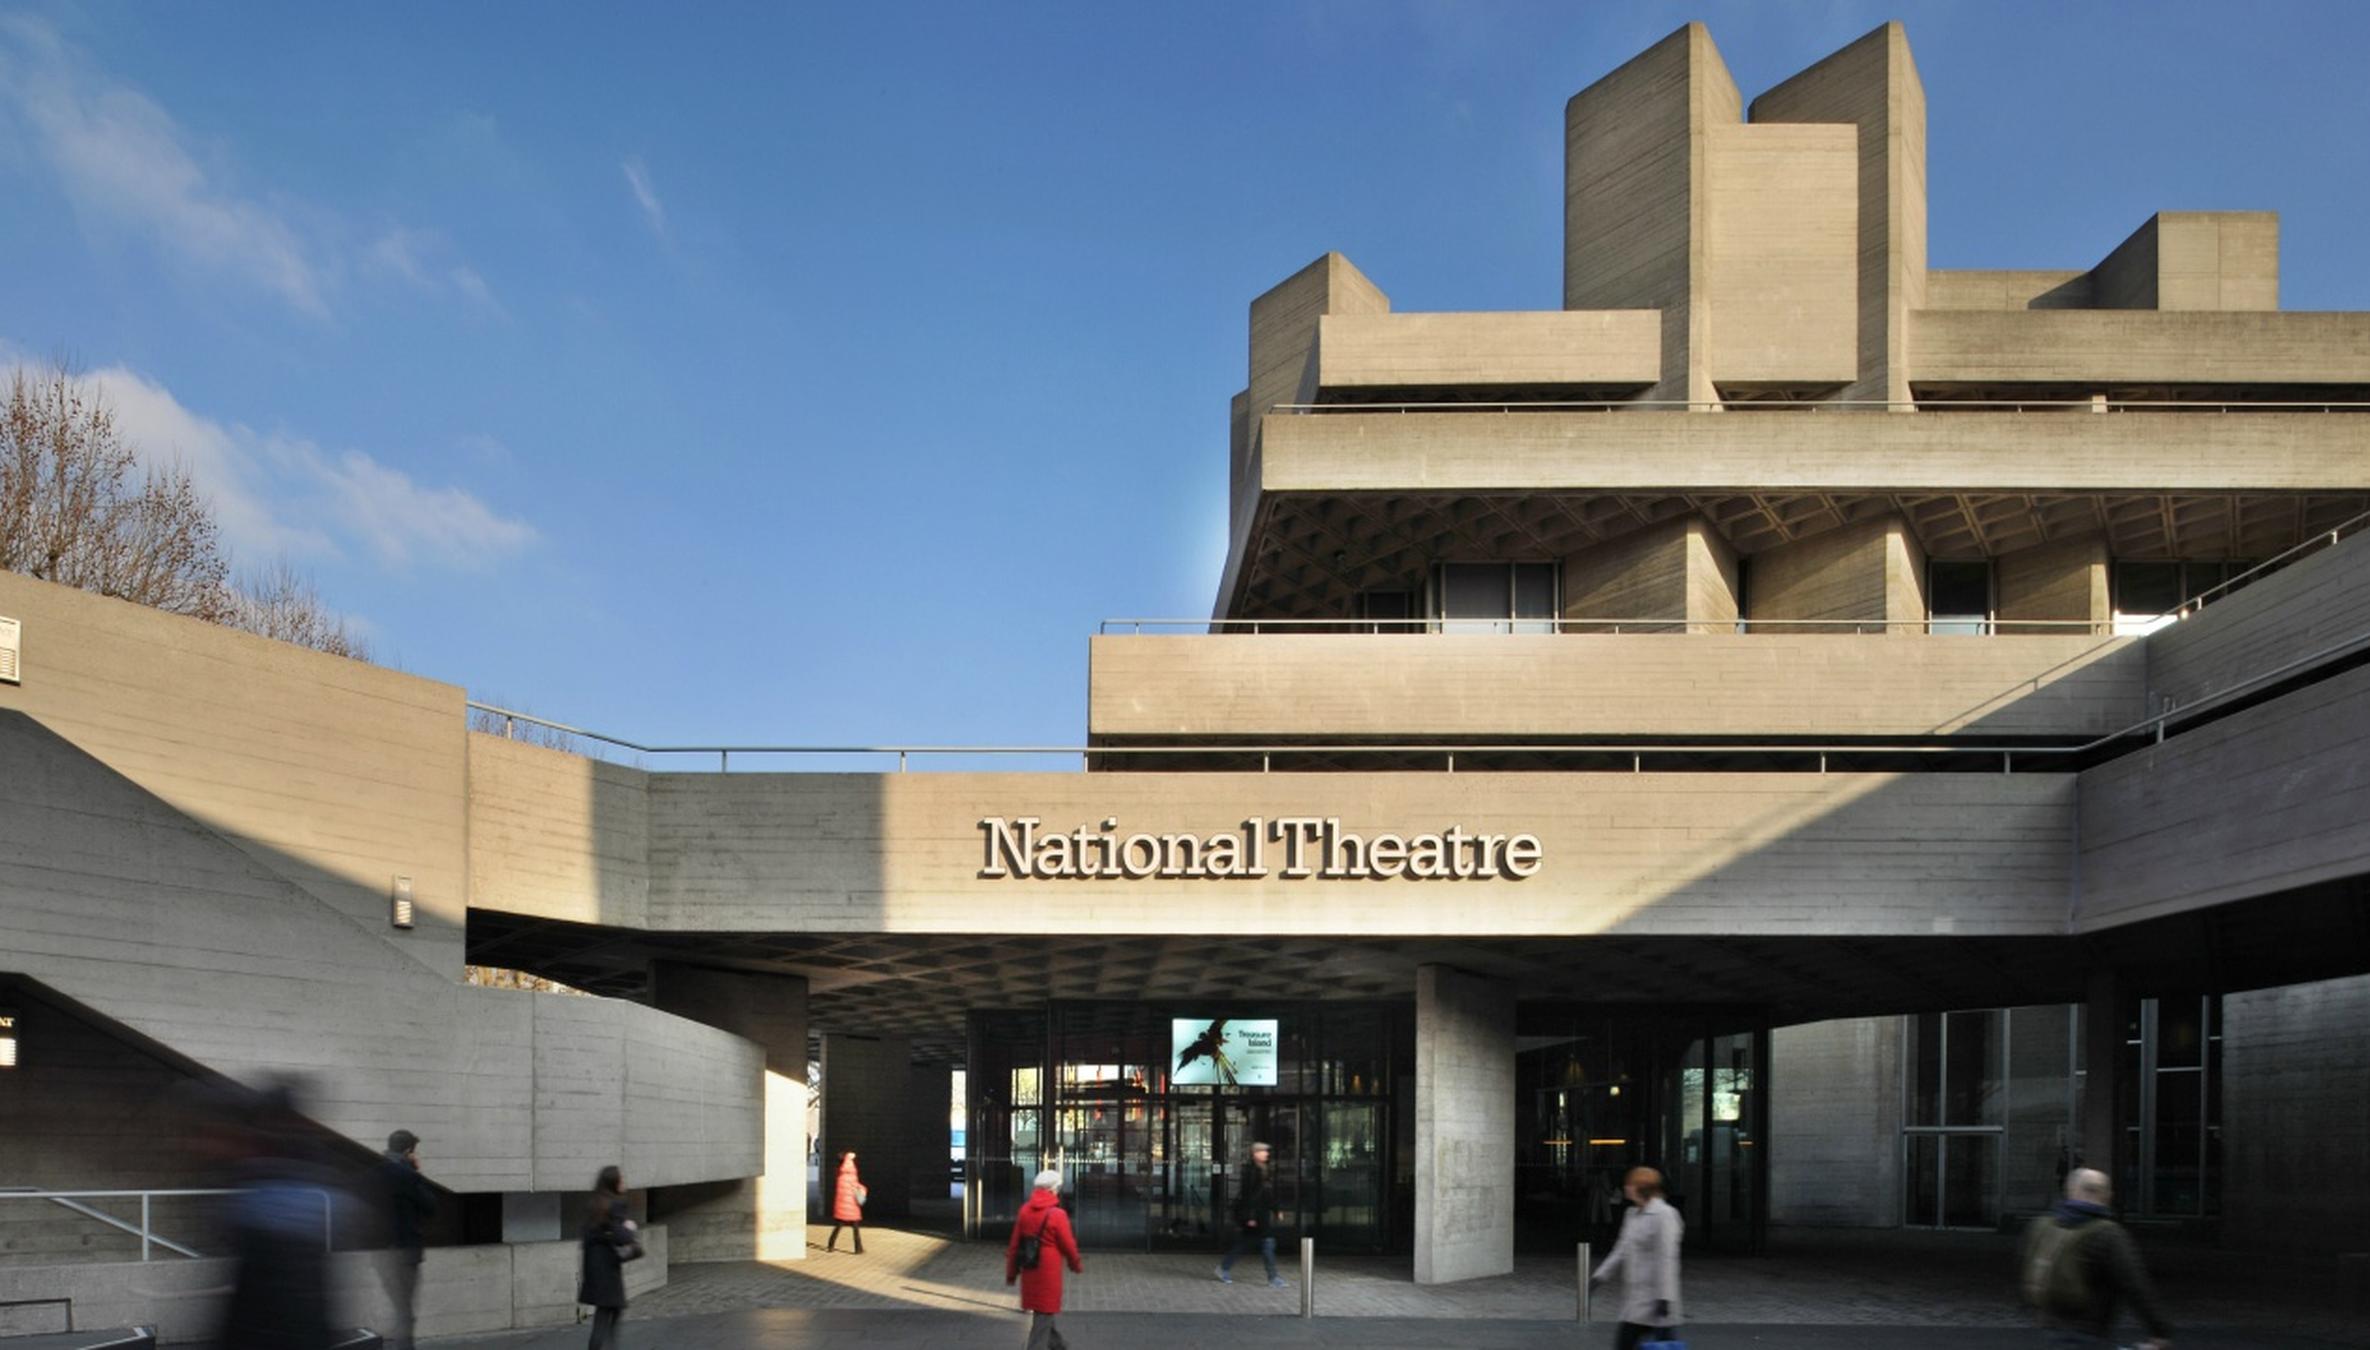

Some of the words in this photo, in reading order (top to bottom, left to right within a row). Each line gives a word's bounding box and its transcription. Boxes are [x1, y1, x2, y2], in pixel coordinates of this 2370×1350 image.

[978, 816, 1267, 880] National
[1270, 816, 1543, 880] Theatre
[1248, 1038, 1272, 1047] Island
